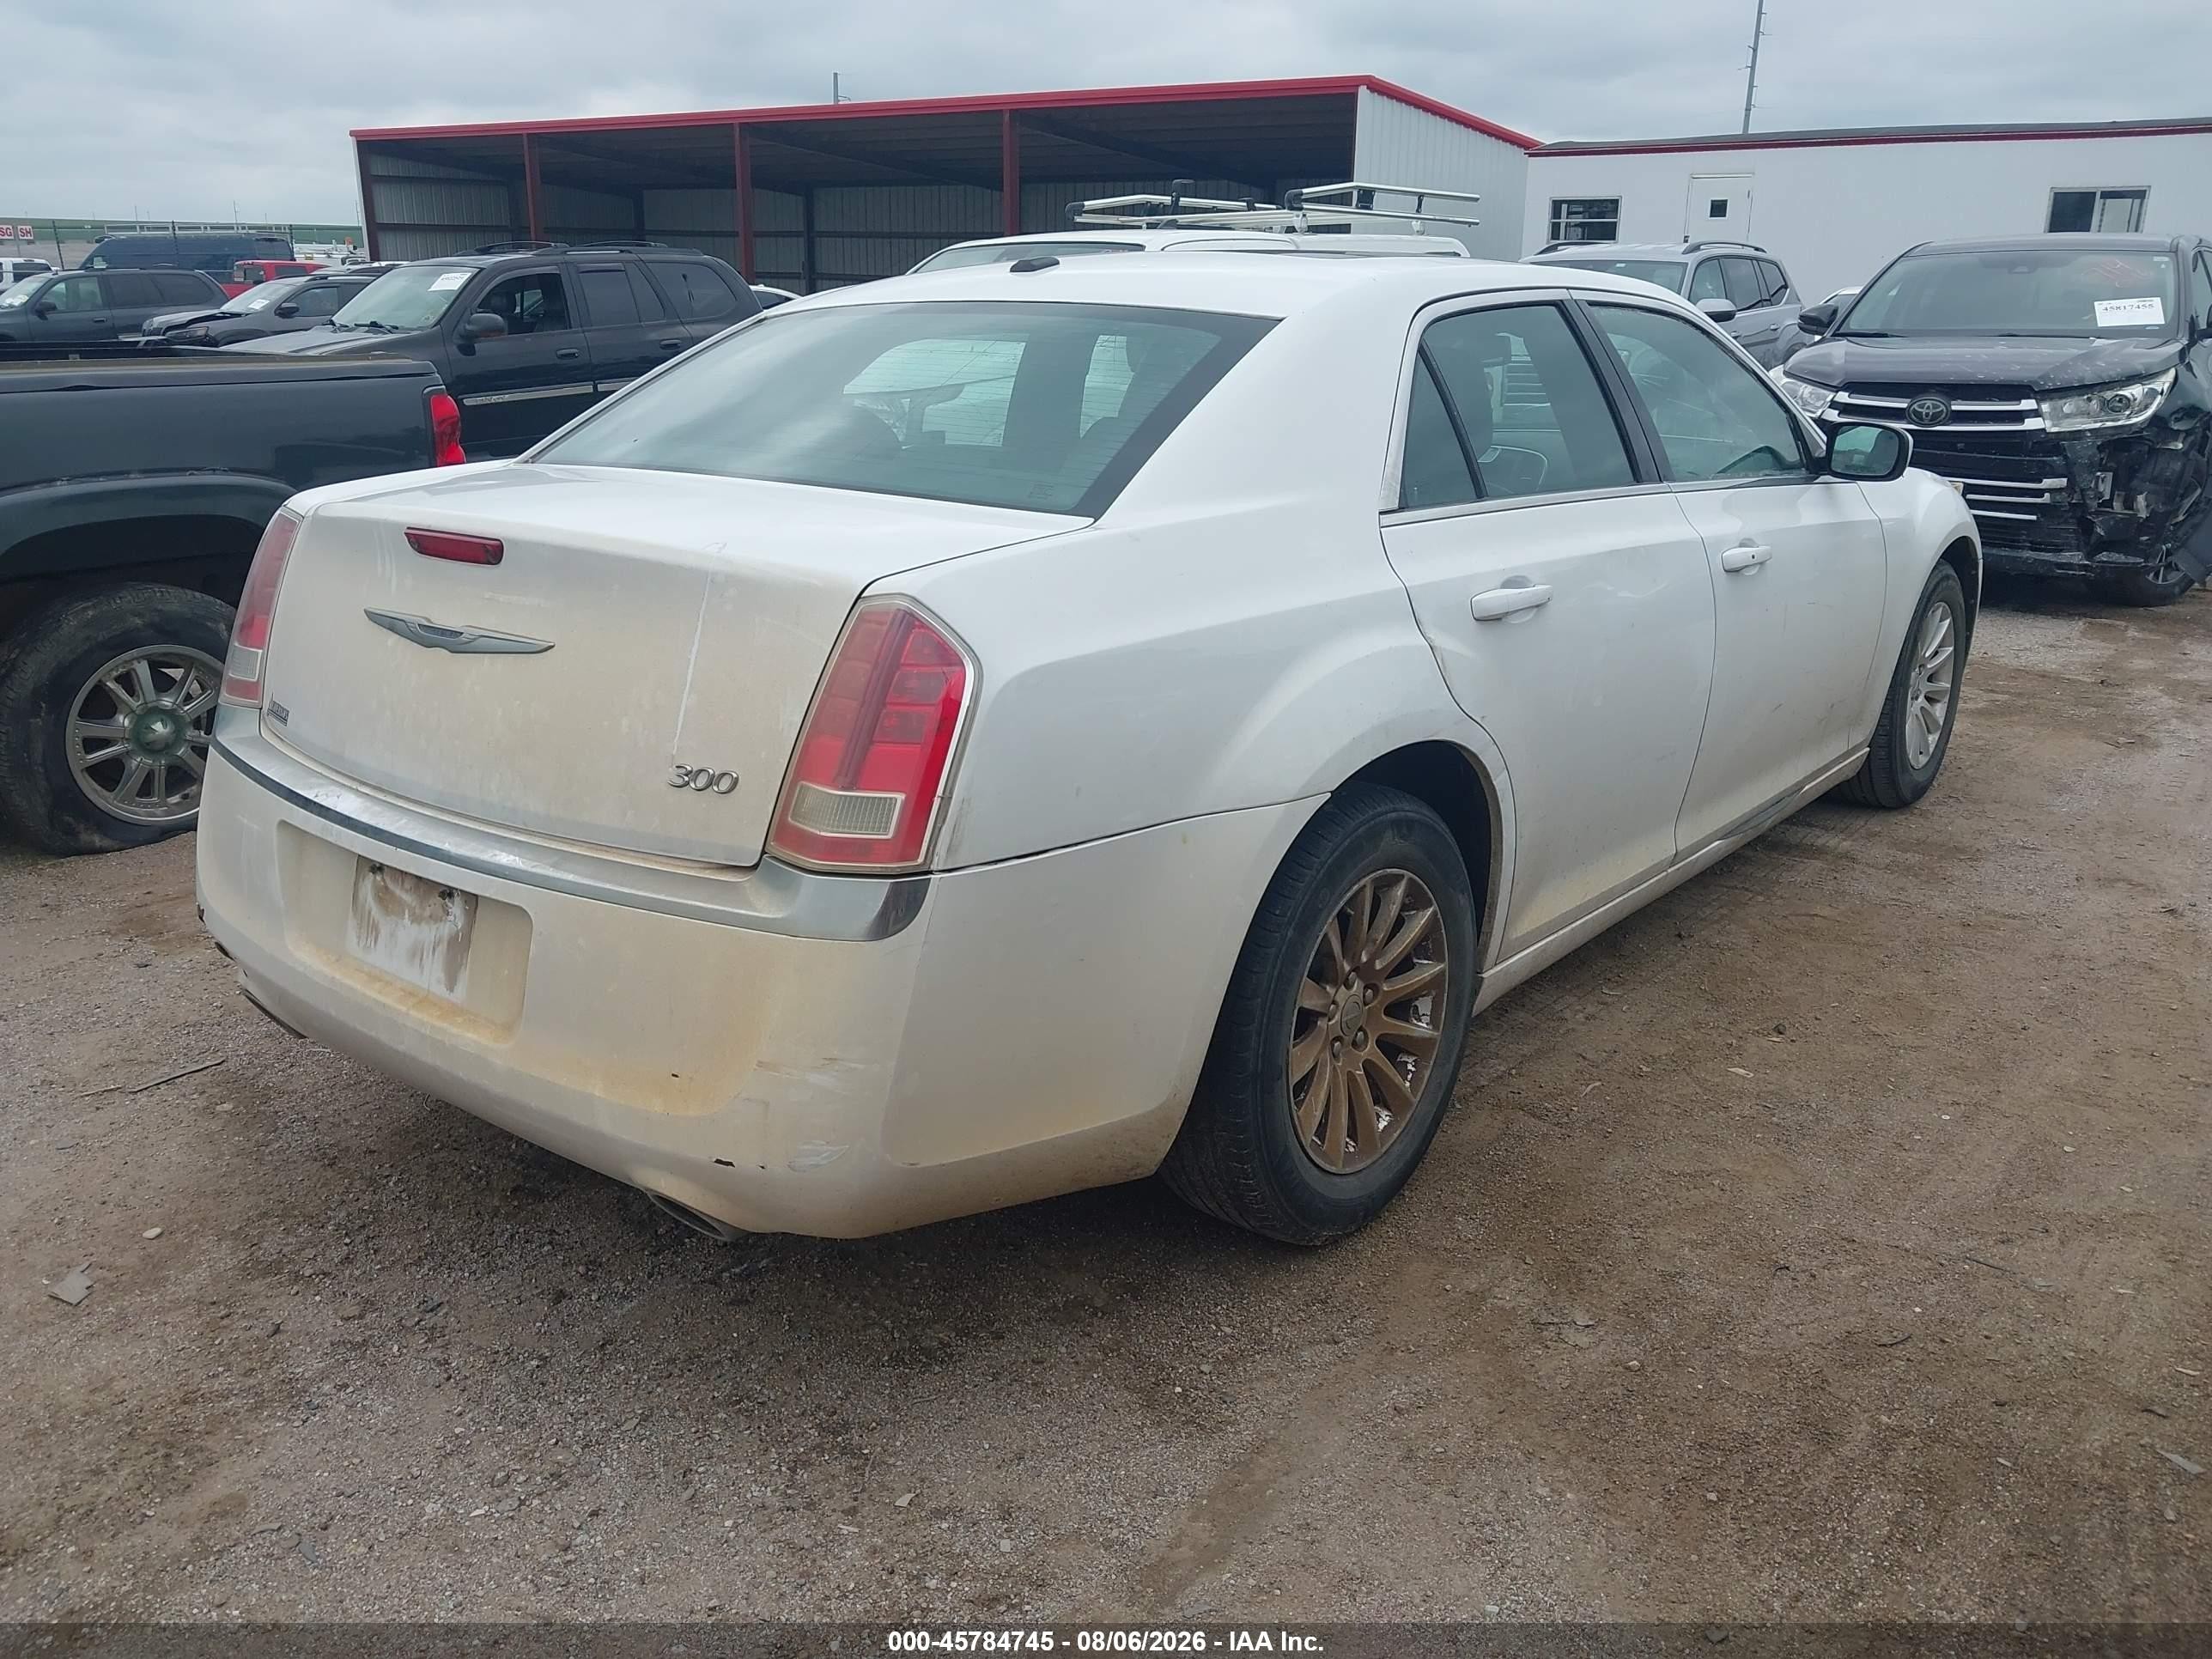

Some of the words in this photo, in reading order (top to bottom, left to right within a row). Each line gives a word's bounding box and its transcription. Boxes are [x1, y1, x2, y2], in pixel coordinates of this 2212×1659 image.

[0, 227, 13, 237] SG
[19, 228, 33, 238] SH
[667, 763, 739, 794] 300
